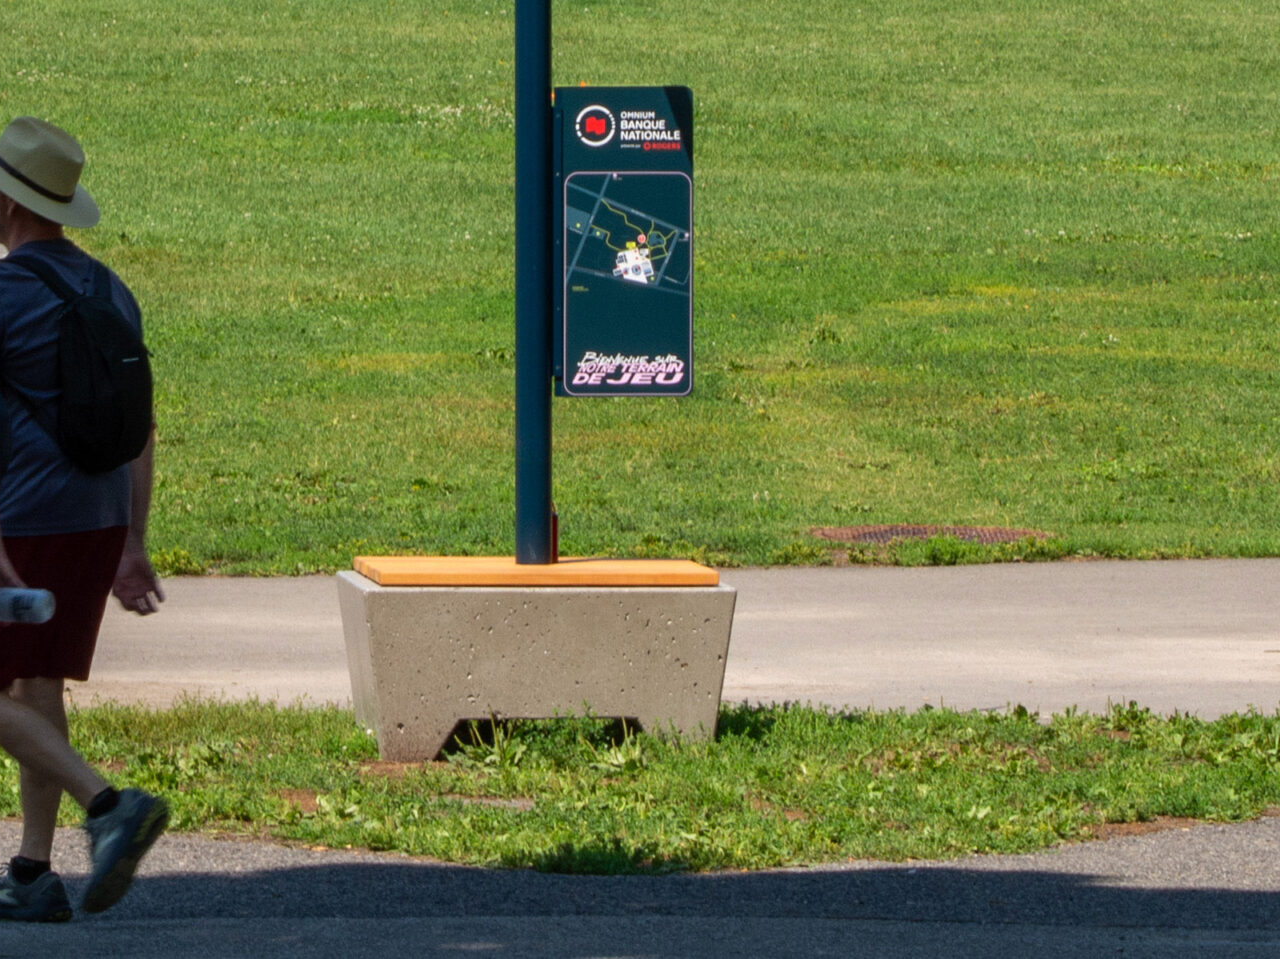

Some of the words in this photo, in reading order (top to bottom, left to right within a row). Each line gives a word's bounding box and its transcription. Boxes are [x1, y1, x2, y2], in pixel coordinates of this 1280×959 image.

[620, 111, 656, 120] OMNIUM
[620, 120, 666, 130] BANQUE
[620, 130, 681, 141] NATIONALE
[621, 362, 685, 373] TERRAIN
[572, 373, 606, 385] DE
[606, 373, 684, 385] JEU
